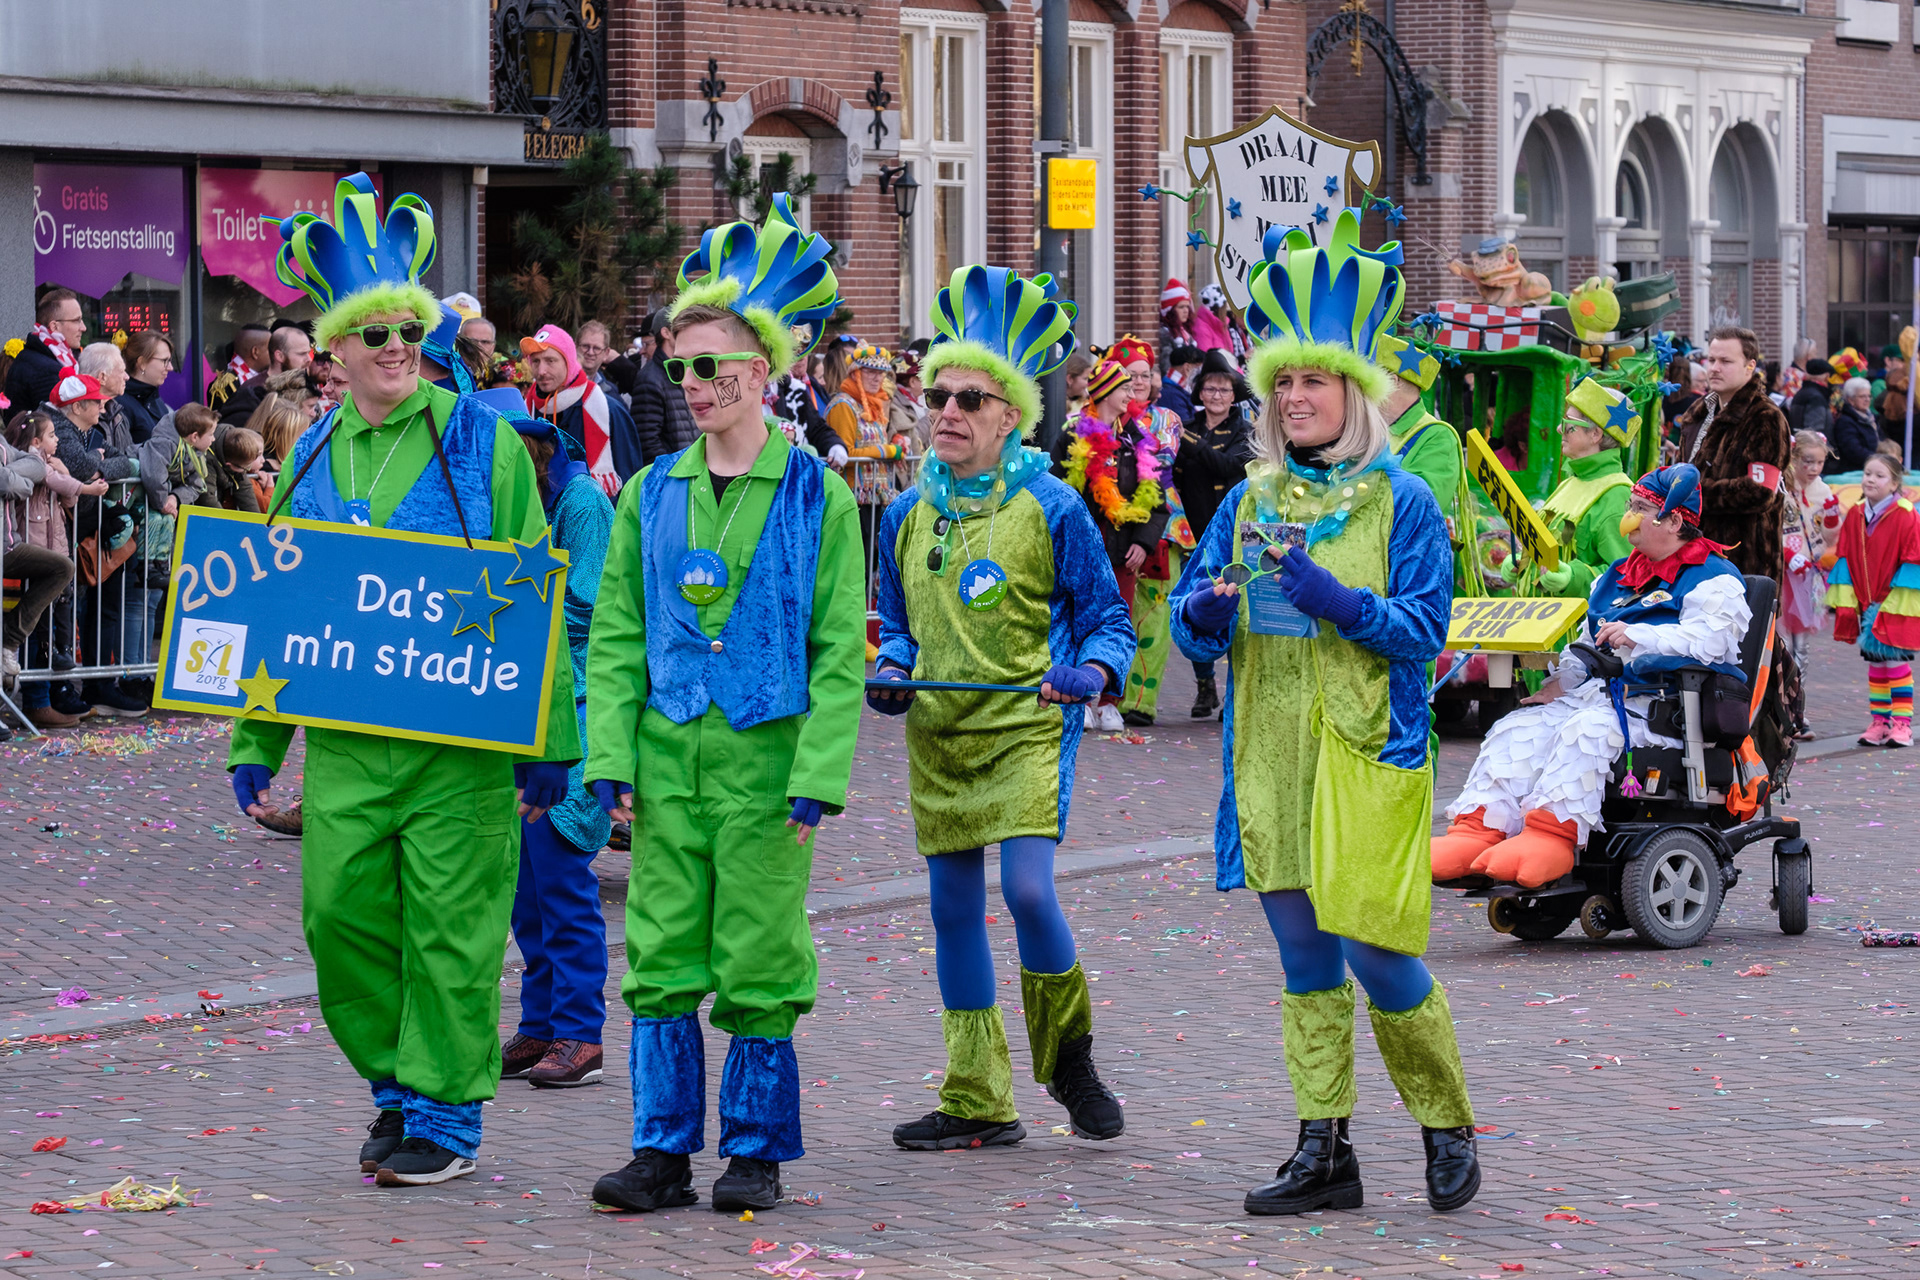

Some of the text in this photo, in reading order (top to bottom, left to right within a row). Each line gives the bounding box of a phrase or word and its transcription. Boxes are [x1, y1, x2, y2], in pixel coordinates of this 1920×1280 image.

[1239, 131, 1318, 169] DRAAI
[62, 185, 109, 211] Gratis
[1260, 175, 1308, 203] MEE
[62, 224, 175, 257] Fietsenstalling
[212, 208, 267, 242] Toilet
[1752, 464, 1765, 483] 5
[1478, 465, 1543, 565] KAANT
[1480, 456, 1538, 547] AGTER
[173, 523, 303, 612] 2018
[357, 573, 445, 622] Da's
[1451, 601, 1563, 620] STARKO
[283, 624, 520, 696] m'n stadje
[196, 674, 228, 690] zorg
